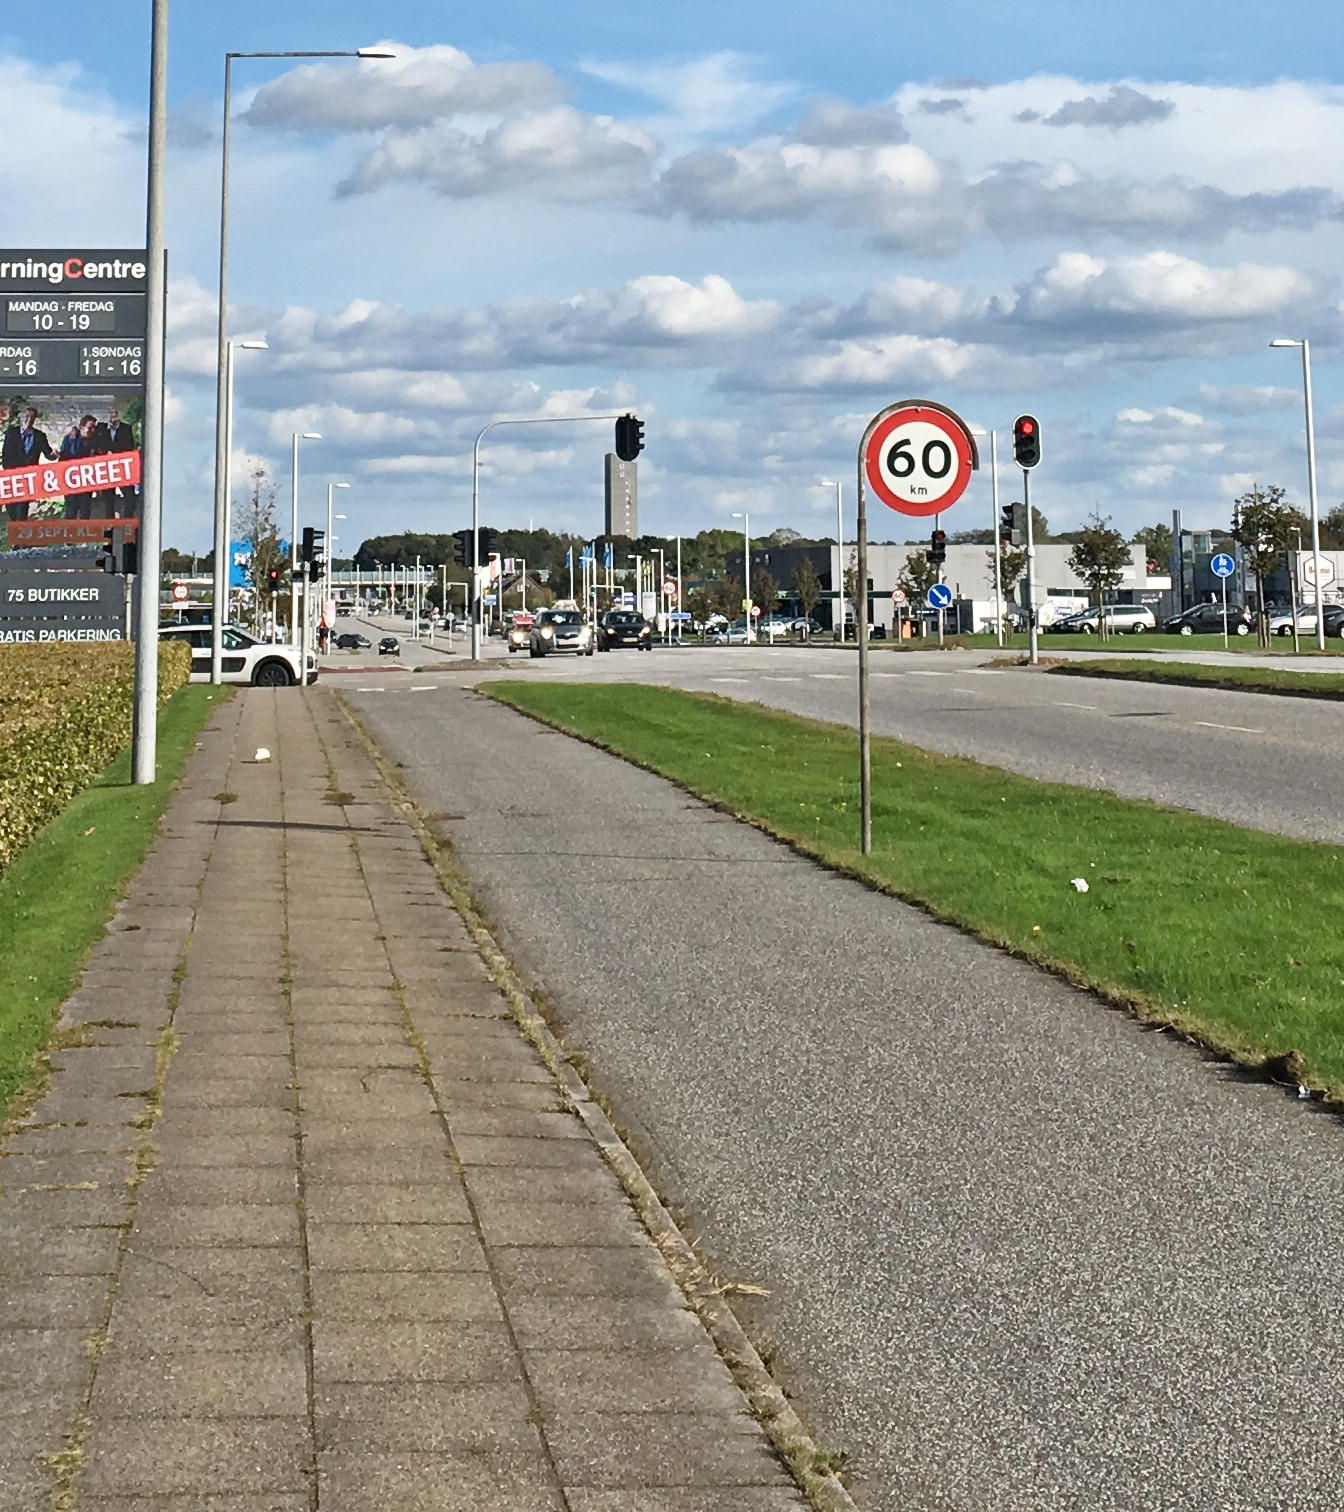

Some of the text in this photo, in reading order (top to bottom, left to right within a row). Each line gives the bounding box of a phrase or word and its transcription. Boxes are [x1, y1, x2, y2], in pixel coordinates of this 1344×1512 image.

[9, 301, 59, 312] MANDAG
[67, 301, 114, 312] FREDAG
[32, 314, 53, 330] 10
[69, 314, 90, 330] 19
[15, 360, 37, 376] 16
[82, 360, 101, 375] 11
[120, 360, 142, 375] 16
[886, 438, 952, 479] 60
[43, 470, 60, 492] &
[64, 458, 134, 488] GREET
[910, 484, 928, 495] km
[8, 588, 99, 602] 75 BUTIKKER
[39, 629, 121, 641] PARKERING
